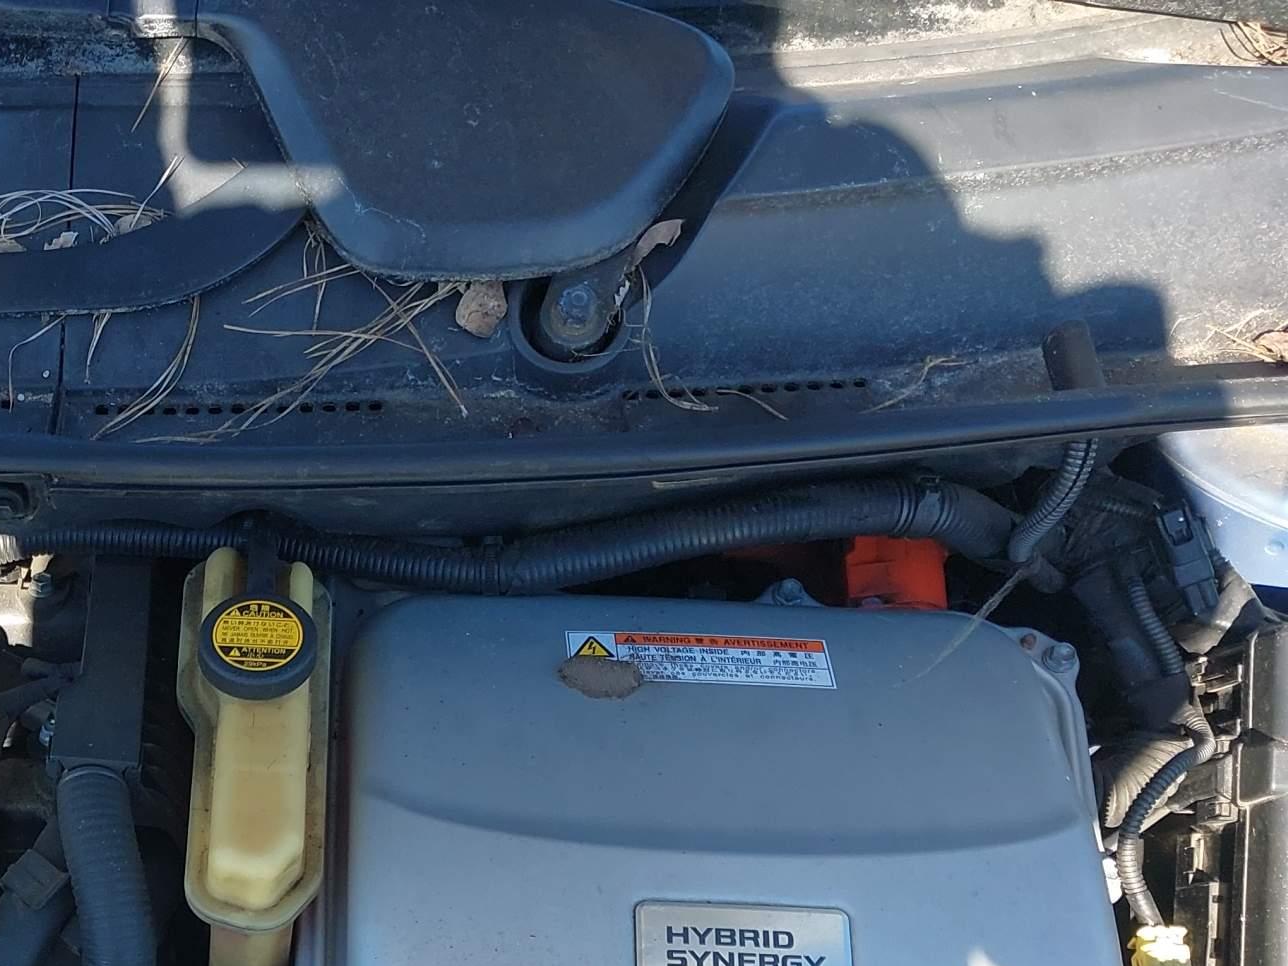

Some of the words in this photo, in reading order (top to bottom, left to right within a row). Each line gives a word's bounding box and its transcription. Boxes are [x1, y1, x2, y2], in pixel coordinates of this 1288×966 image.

[242, 610, 284, 618] CAUTION
[643, 635, 691, 644] WARNING
[723, 639, 809, 650] AVERTISSEMENT
[241, 647, 286, 655] ATTENTION
[655, 646, 696, 655] VOLTAGE
[699, 647, 729, 655] INSIDE
[629, 652, 657, 661] HAUTE
[661, 654, 697, 662] TENSION
[666, 926, 794, 949] HYBRID
